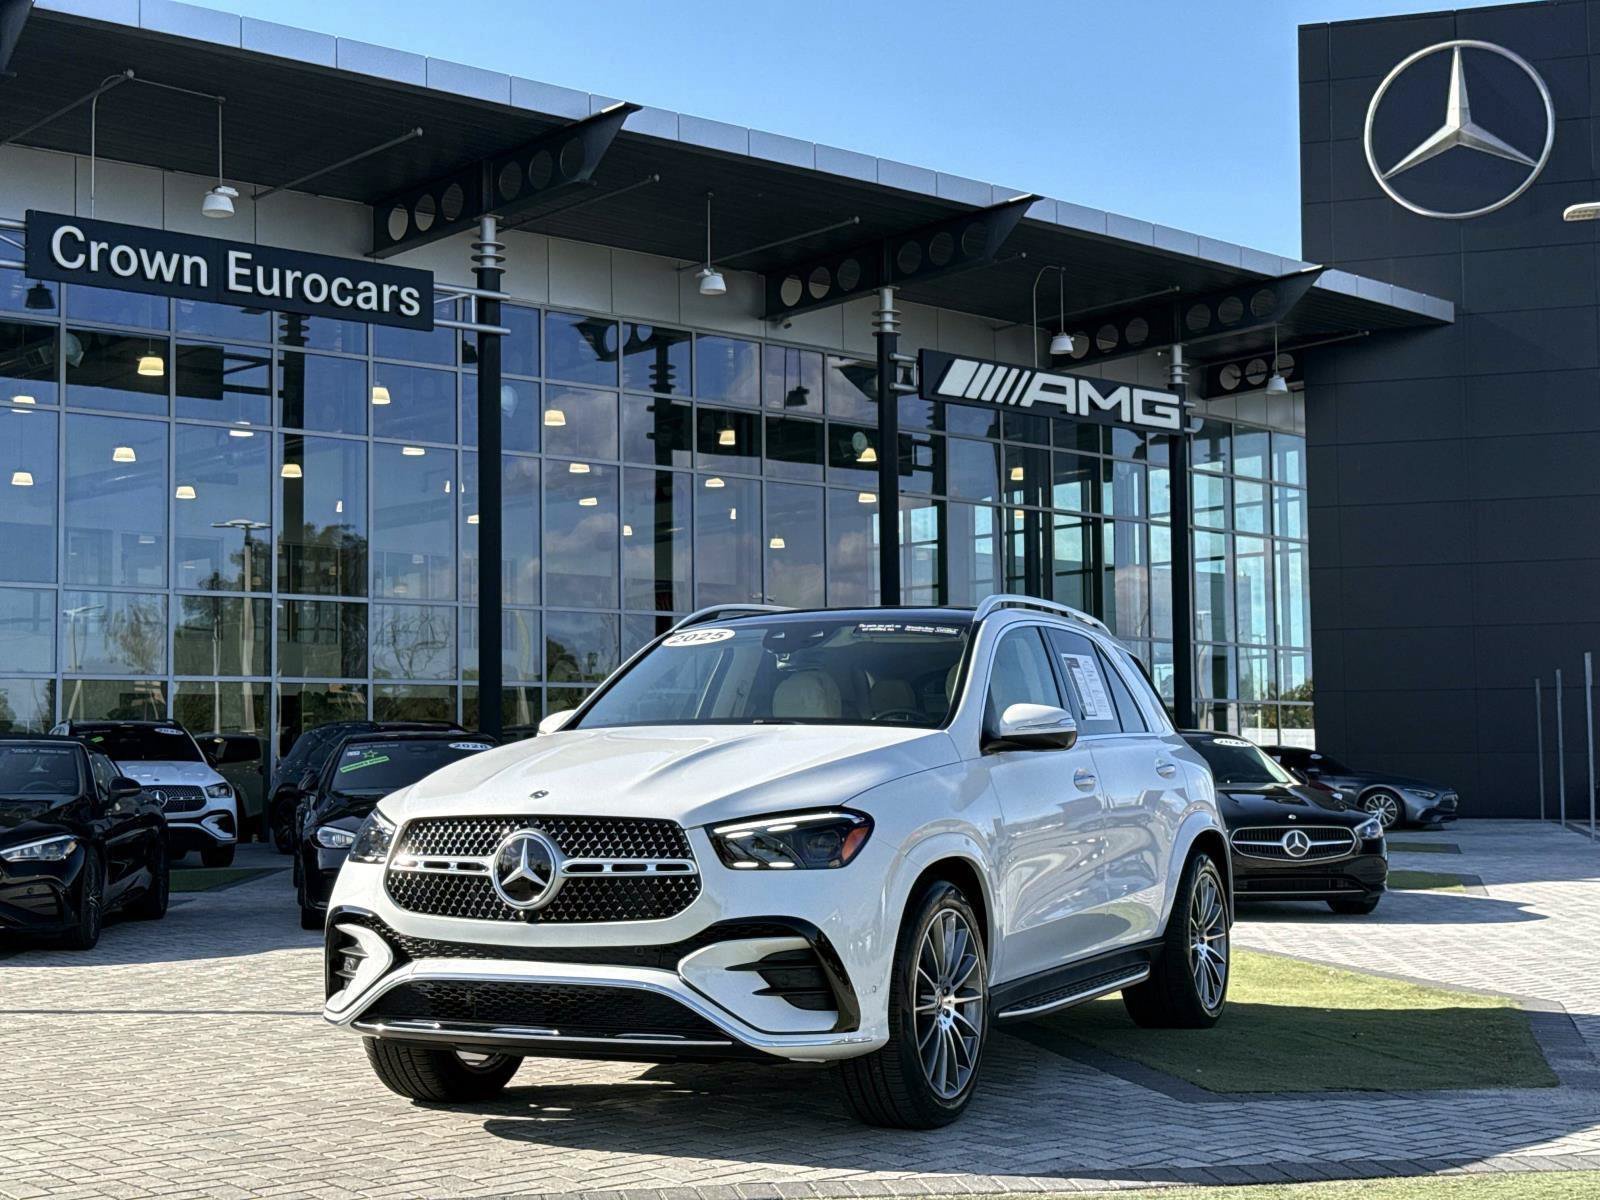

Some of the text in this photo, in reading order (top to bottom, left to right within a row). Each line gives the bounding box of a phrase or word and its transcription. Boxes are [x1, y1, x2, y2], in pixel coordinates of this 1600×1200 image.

[52, 225, 421, 317] Crown Eurocars
[1019, 371, 1181, 430] AMG
[668, 631, 728, 645] 2025
